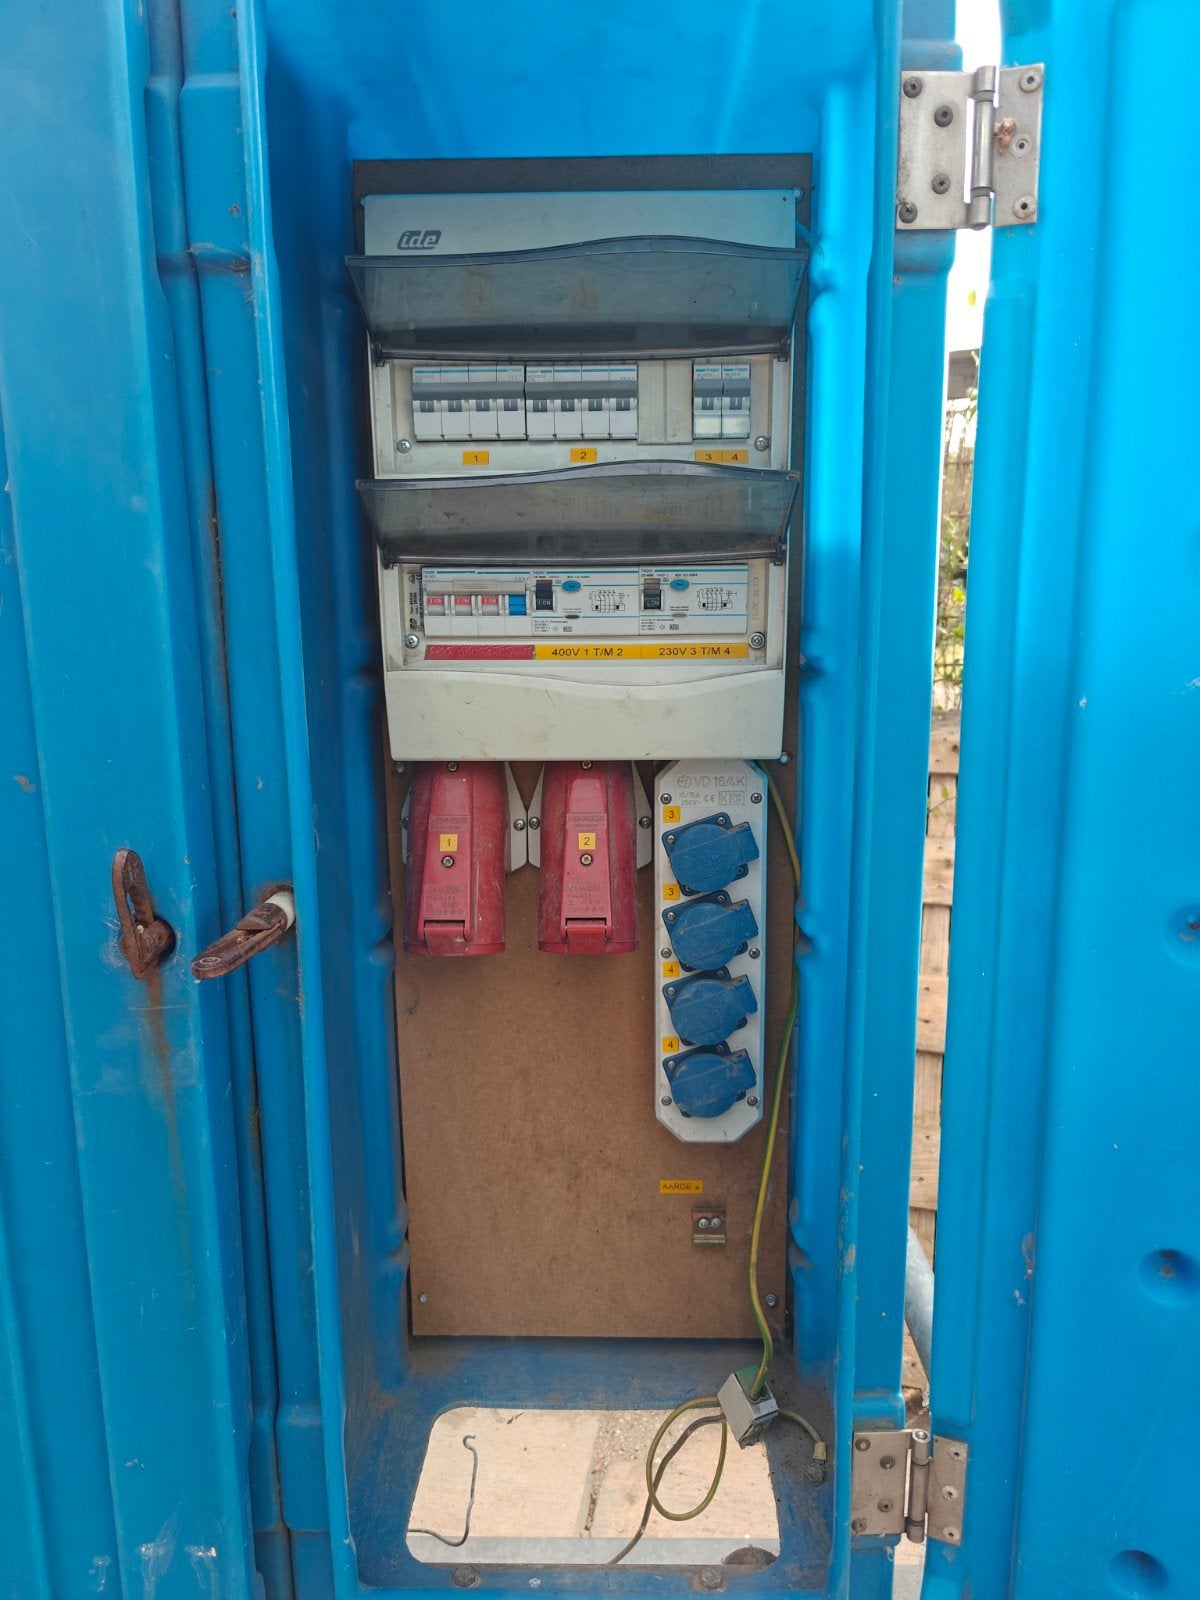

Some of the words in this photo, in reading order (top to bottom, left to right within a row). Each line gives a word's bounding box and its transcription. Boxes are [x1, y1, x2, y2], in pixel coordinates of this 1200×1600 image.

[398, 230, 440, 249] ide
[473, 454, 478, 463] 1
[580, 451, 587, 460] 2
[705, 453, 712, 461] 3
[731, 453, 738, 461] 4
[551, 648, 580, 657] 400V
[584, 648, 589, 656] 1
[593, 647, 614, 656] T/M
[616, 648, 623, 656] 2
[659, 647, 687, 656] 230V
[690, 647, 697, 655] 3
[701, 646, 721, 655] T/M
[724, 647, 731, 655] 4
[694, 776, 710, 787] VD
[668, 810, 675, 819] 3
[447, 838, 451, 847] 1
[583, 837, 591, 846] 2
[668, 887, 674, 896] 3
[667, 965, 674, 974] 4
[667, 1040, 674, 1049] 4
[662, 1182, 692, 1190] AARDE
